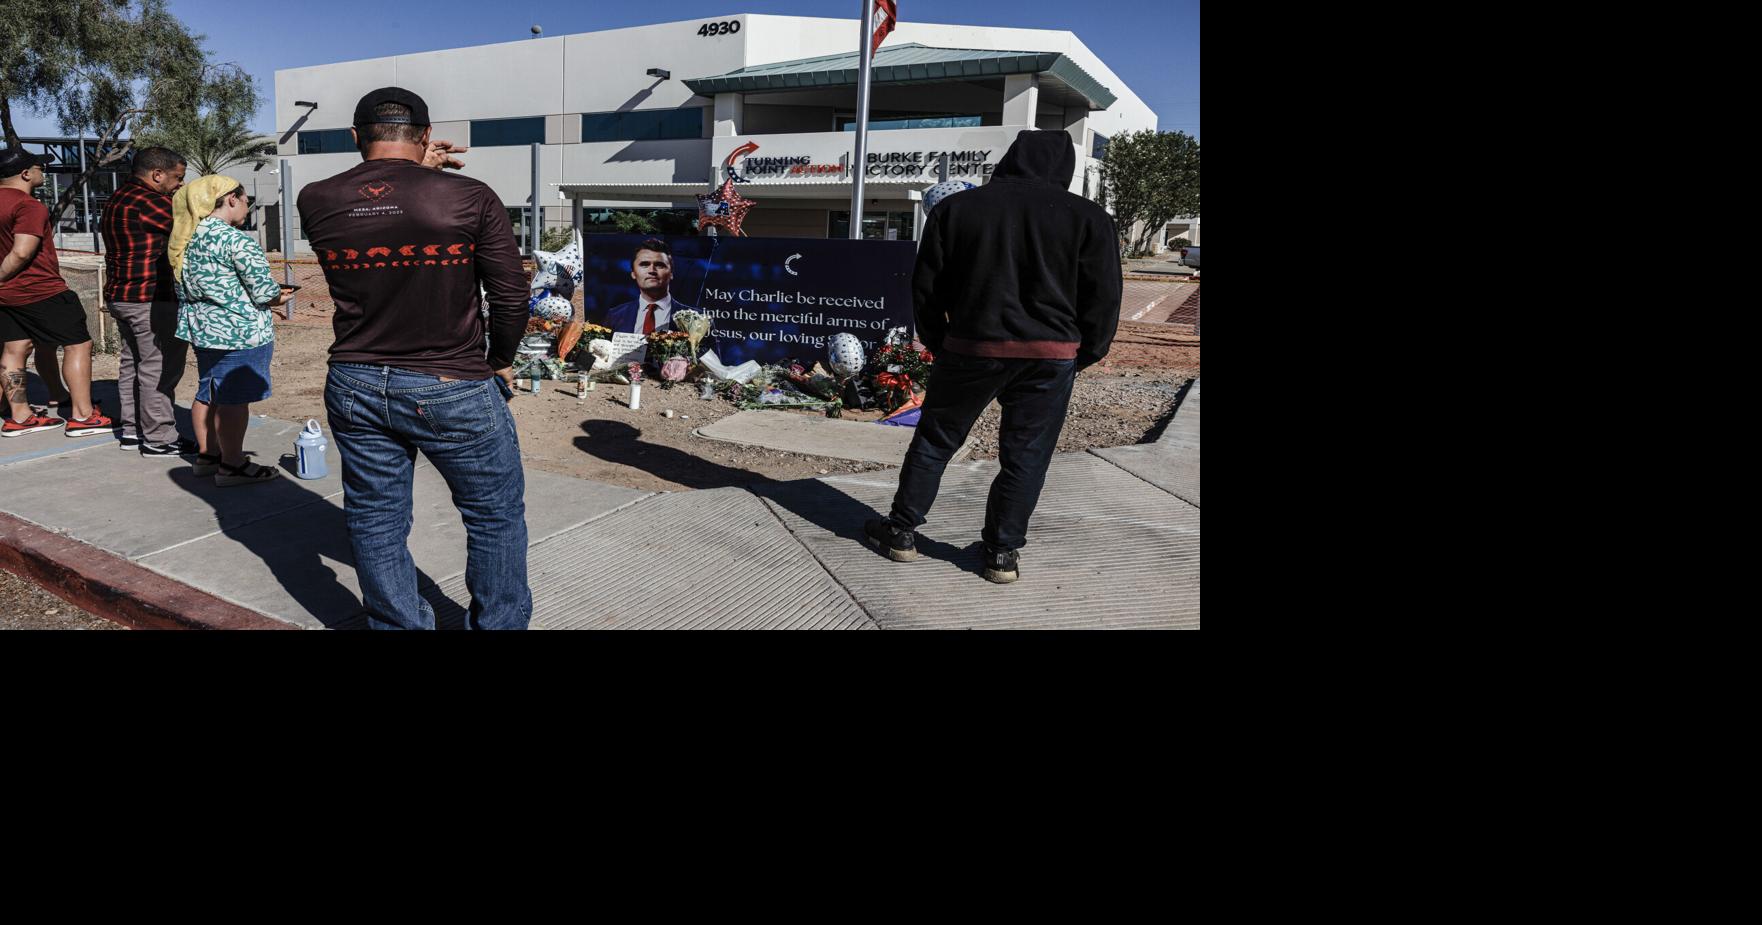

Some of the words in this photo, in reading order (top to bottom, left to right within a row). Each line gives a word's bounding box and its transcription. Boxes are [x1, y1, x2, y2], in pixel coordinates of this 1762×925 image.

[697, 20, 741, 37] 4930
[745, 156, 811, 166] TURNING
[867, 152, 922, 163] BURKE
[929, 150, 992, 162] FAMILY
[745, 166, 786, 175] POINT
[851, 164, 927, 176] ICTORY
[933, 163, 1000, 175] CENTE
[705, 288, 736, 303] May
[738, 289, 793, 303] Charlie
[796, 291, 816, 305] be
[819, 296, 884, 310] received
[702, 307, 730, 319] into
[733, 308, 758, 320] the
[760, 312, 823, 325] merciful
[826, 317, 867, 328] arms
[870, 317, 891, 331] of
[704, 328, 746, 340] Jesus,
[749, 331, 776, 341] our
[779, 330, 825, 348] loving
